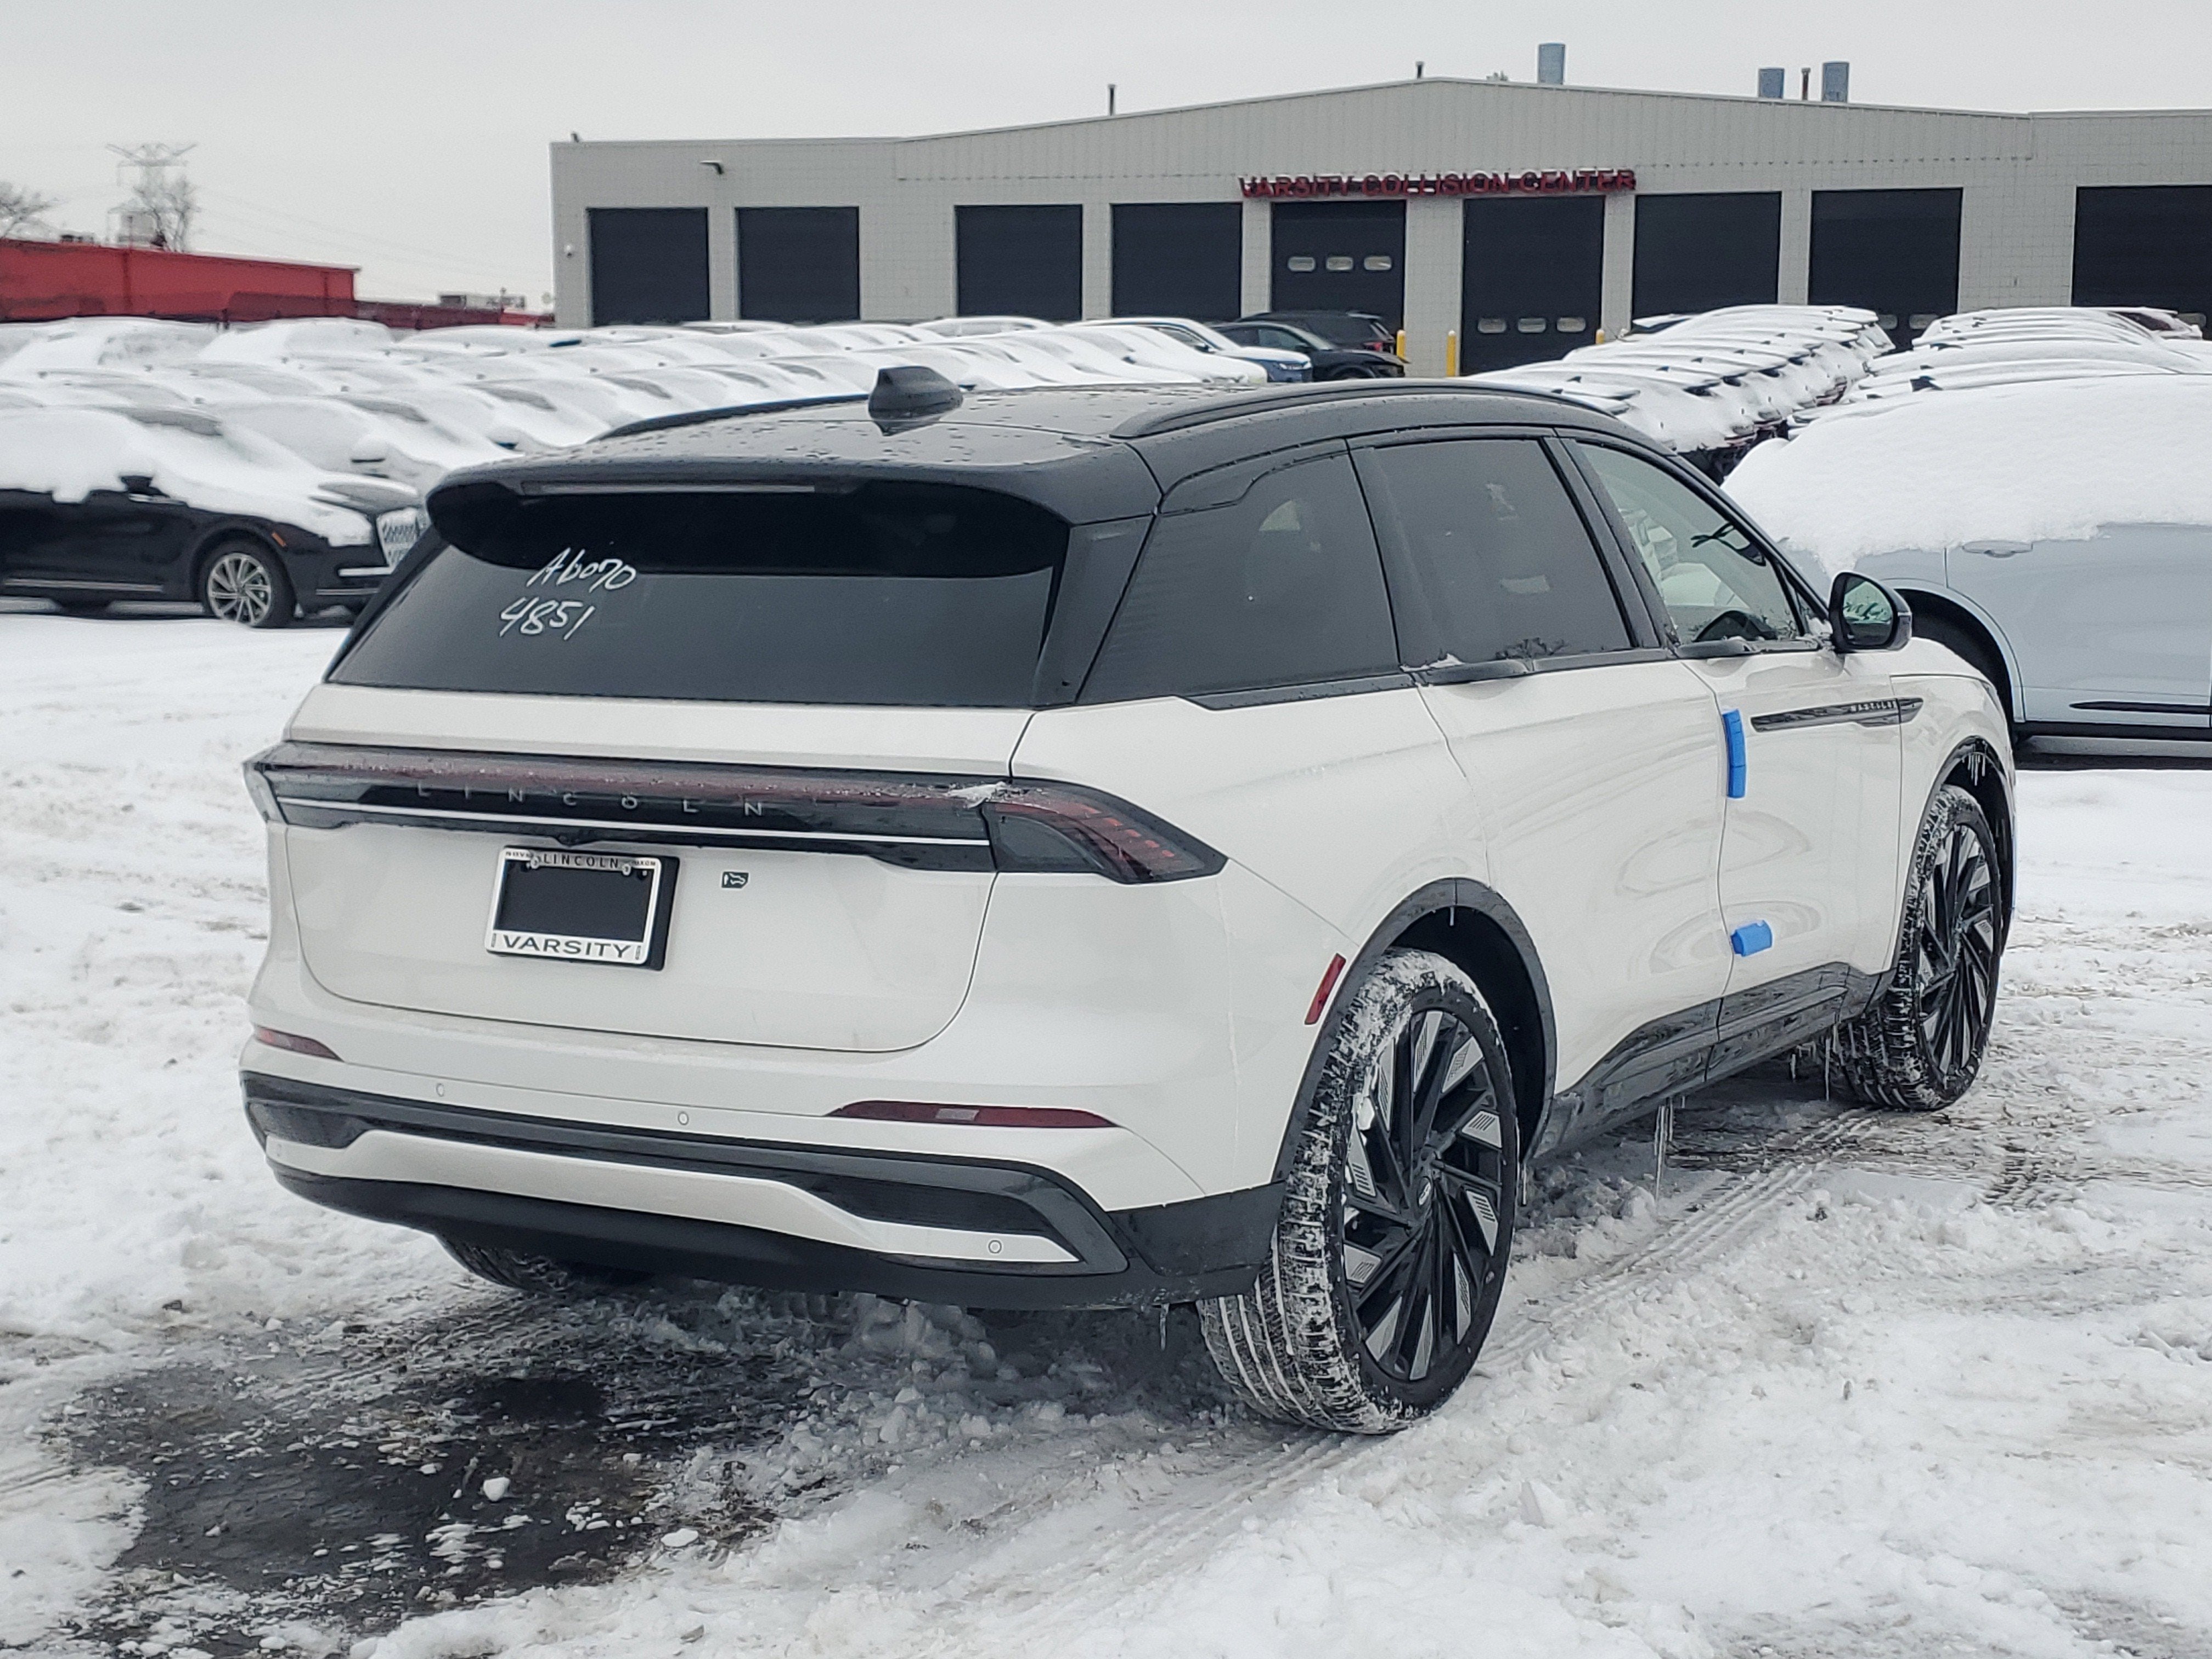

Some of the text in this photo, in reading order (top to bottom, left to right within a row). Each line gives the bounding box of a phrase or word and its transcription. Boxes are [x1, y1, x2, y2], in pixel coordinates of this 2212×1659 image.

[1238, 169, 1637, 198] VARSITY COLLISION CENTER
[499, 596, 596, 641] 4851
[417, 783, 763, 817] LINCOLN
[543, 853, 619, 868] LINCOLN
[503, 934, 631, 958] VARSITY
